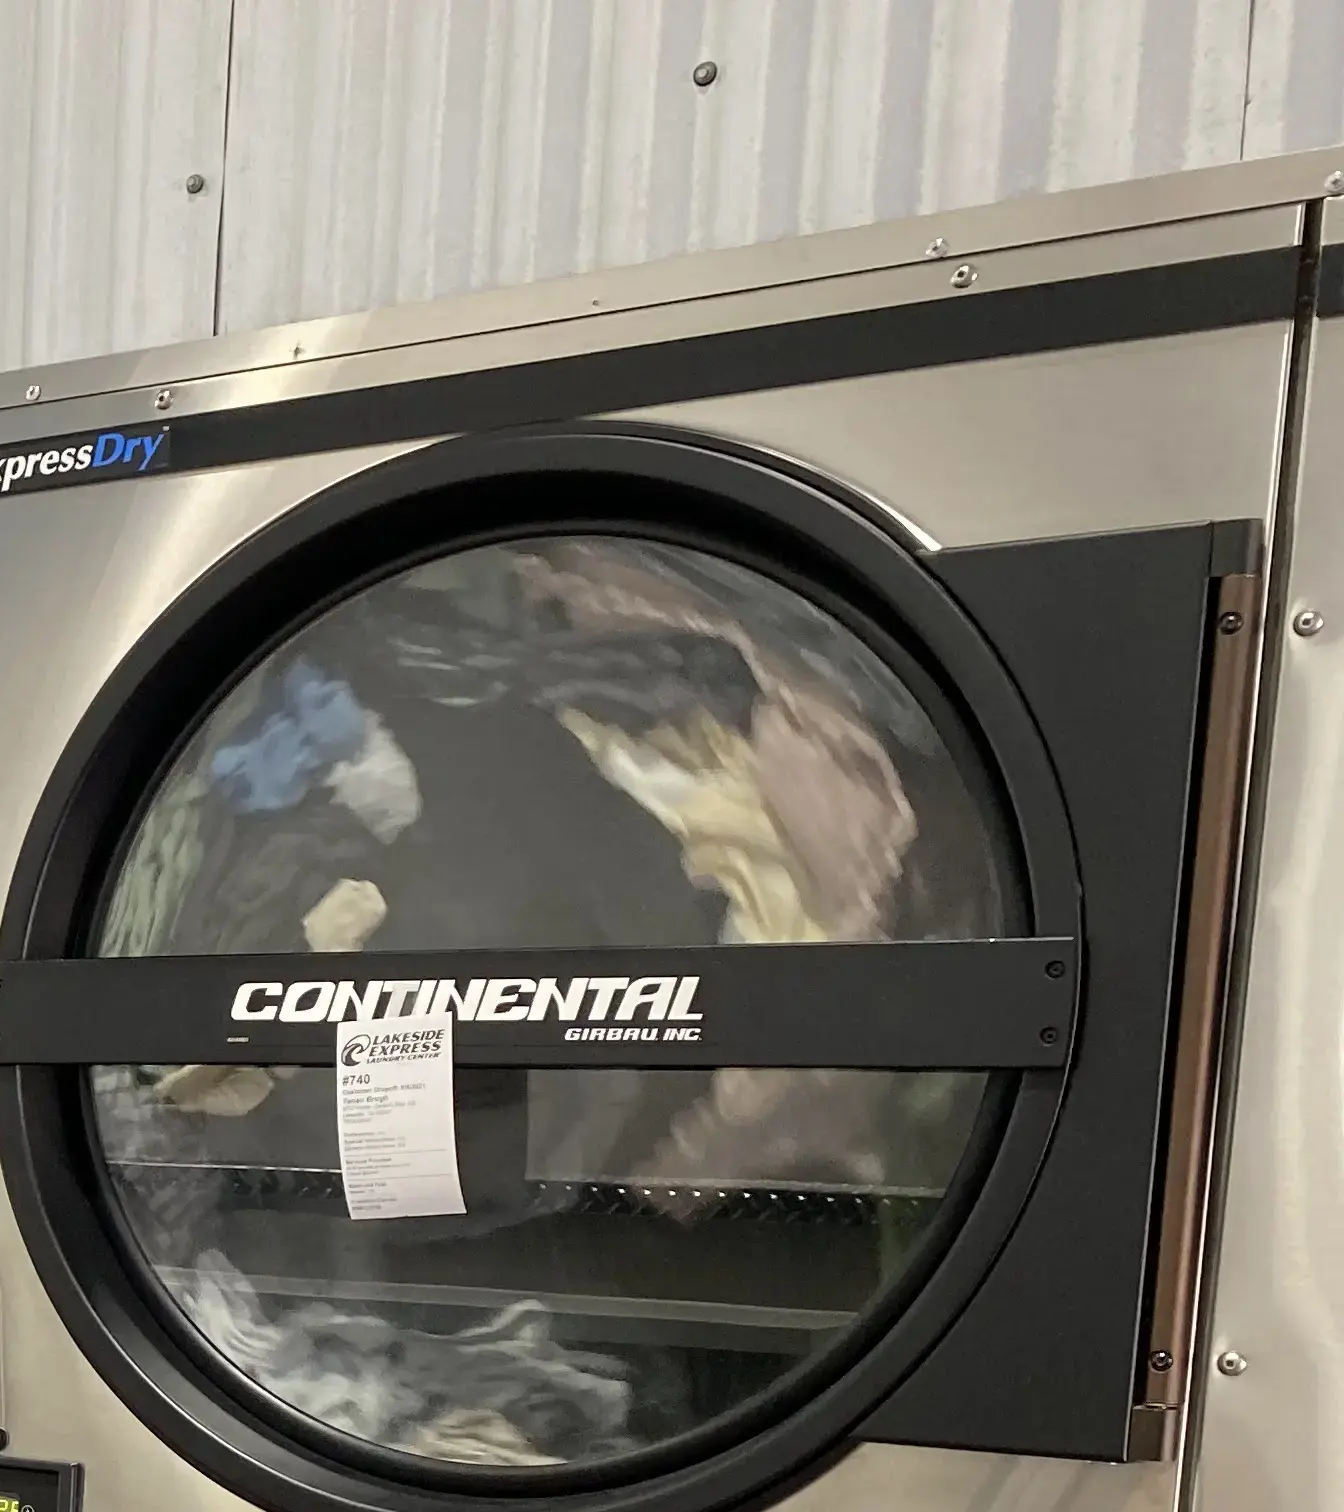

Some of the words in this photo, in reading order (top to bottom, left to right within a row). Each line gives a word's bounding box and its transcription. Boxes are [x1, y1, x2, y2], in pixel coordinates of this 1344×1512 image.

[231, 976, 704, 1022] CONTINENTAL
[373, 1029, 445, 1045] LAKESIDE
[369, 1040, 441, 1057] EXPRESS
[342, 1073, 370, 1086] #740
